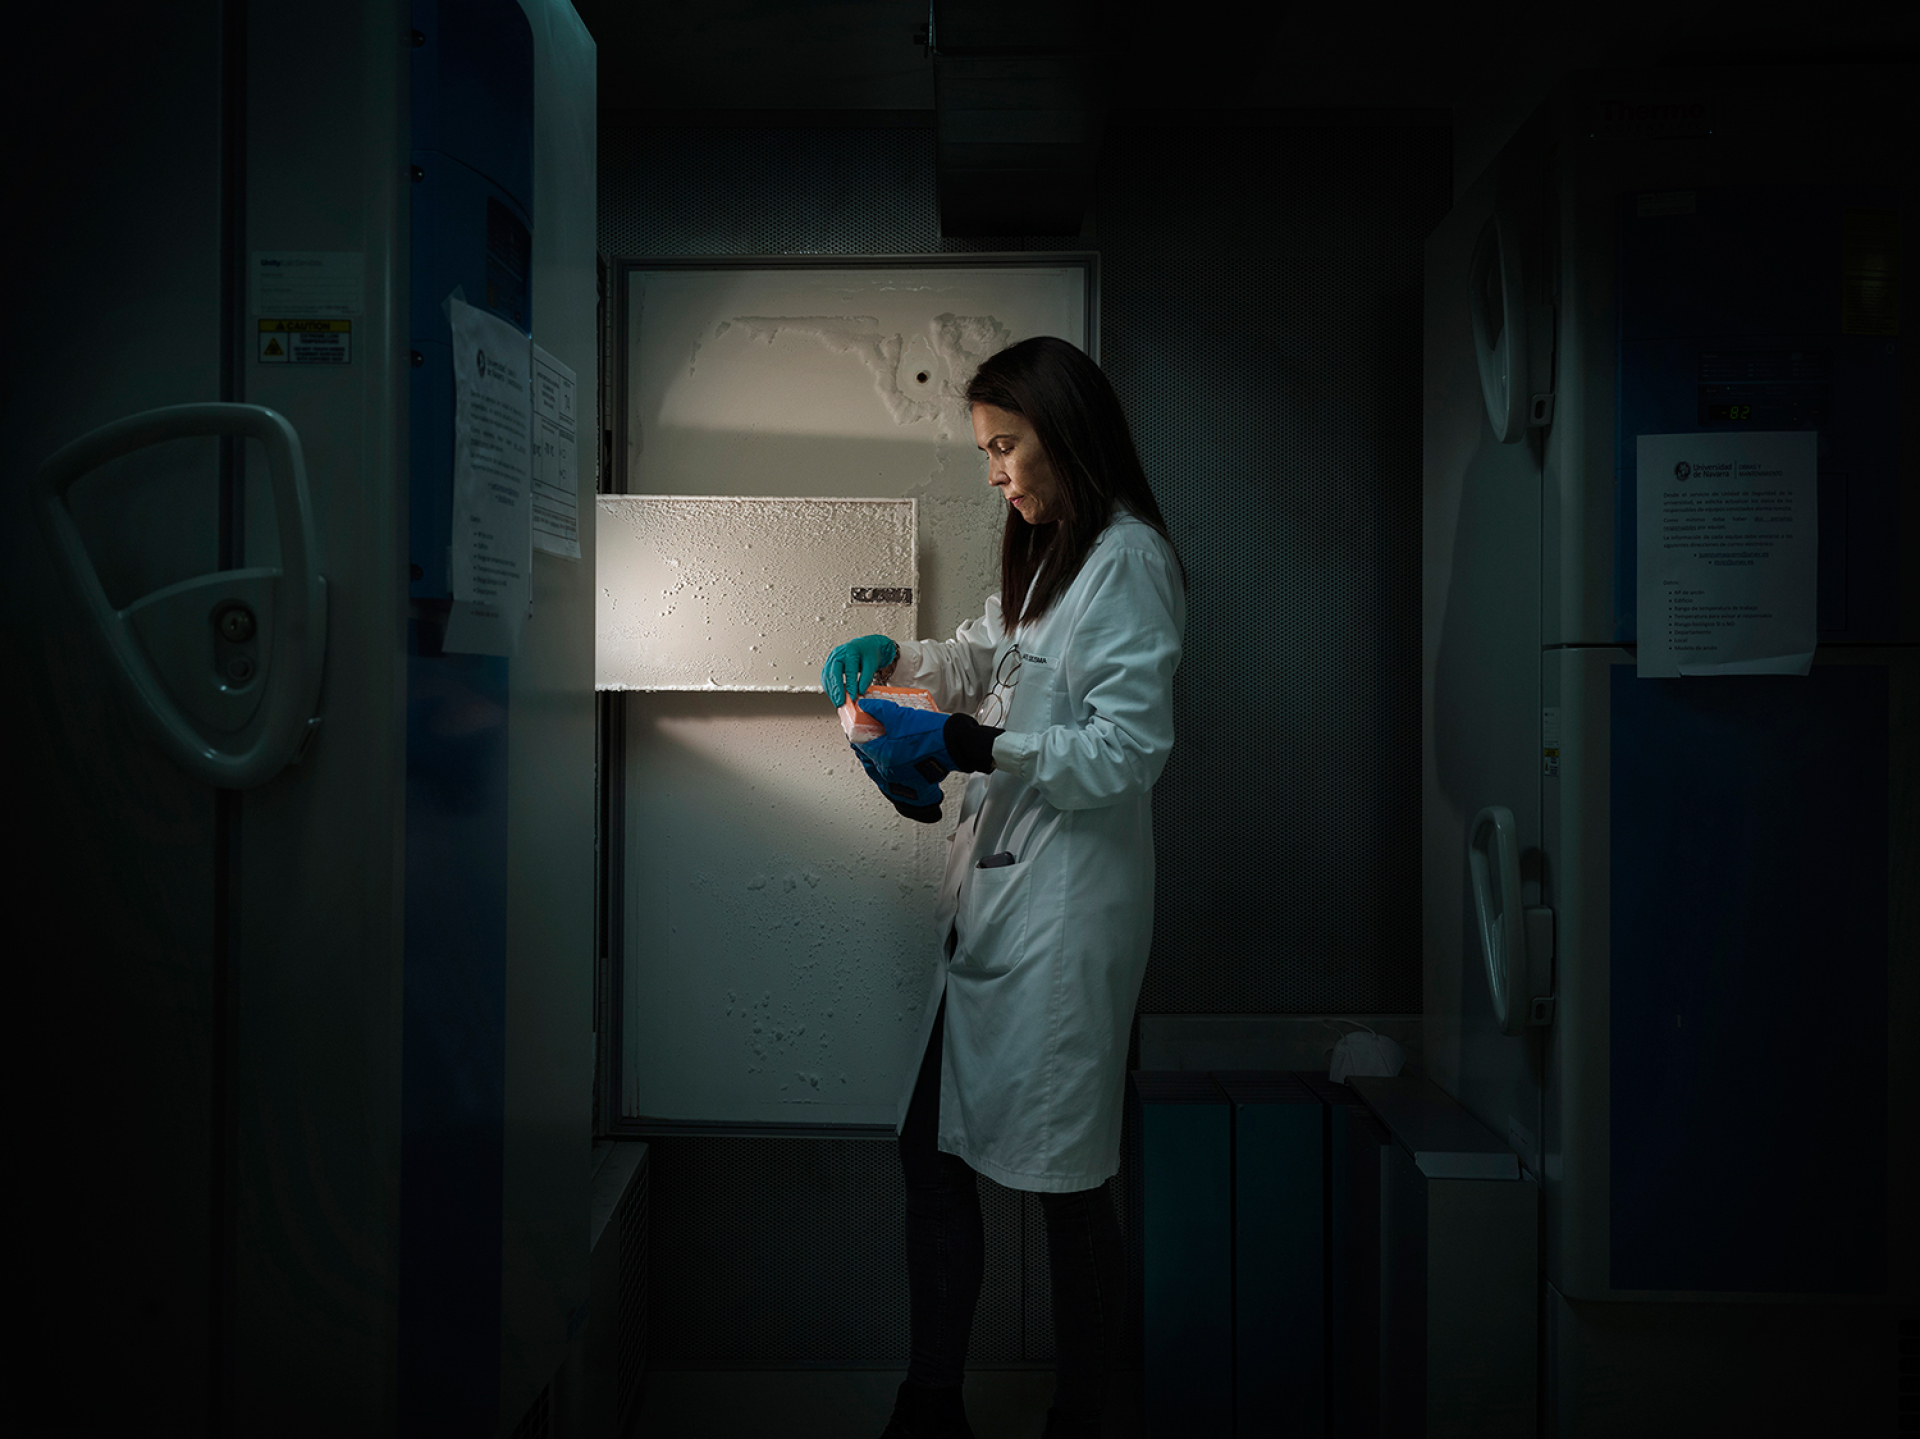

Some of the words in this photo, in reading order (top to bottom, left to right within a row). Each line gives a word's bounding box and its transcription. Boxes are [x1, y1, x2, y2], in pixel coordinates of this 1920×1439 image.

[1600, 99, 1706, 121] Thermo
[287, 322, 331, 330] CAUTION
[1720, 405, 1751, 420] -82
[1693, 463, 1732, 471] Universidad
